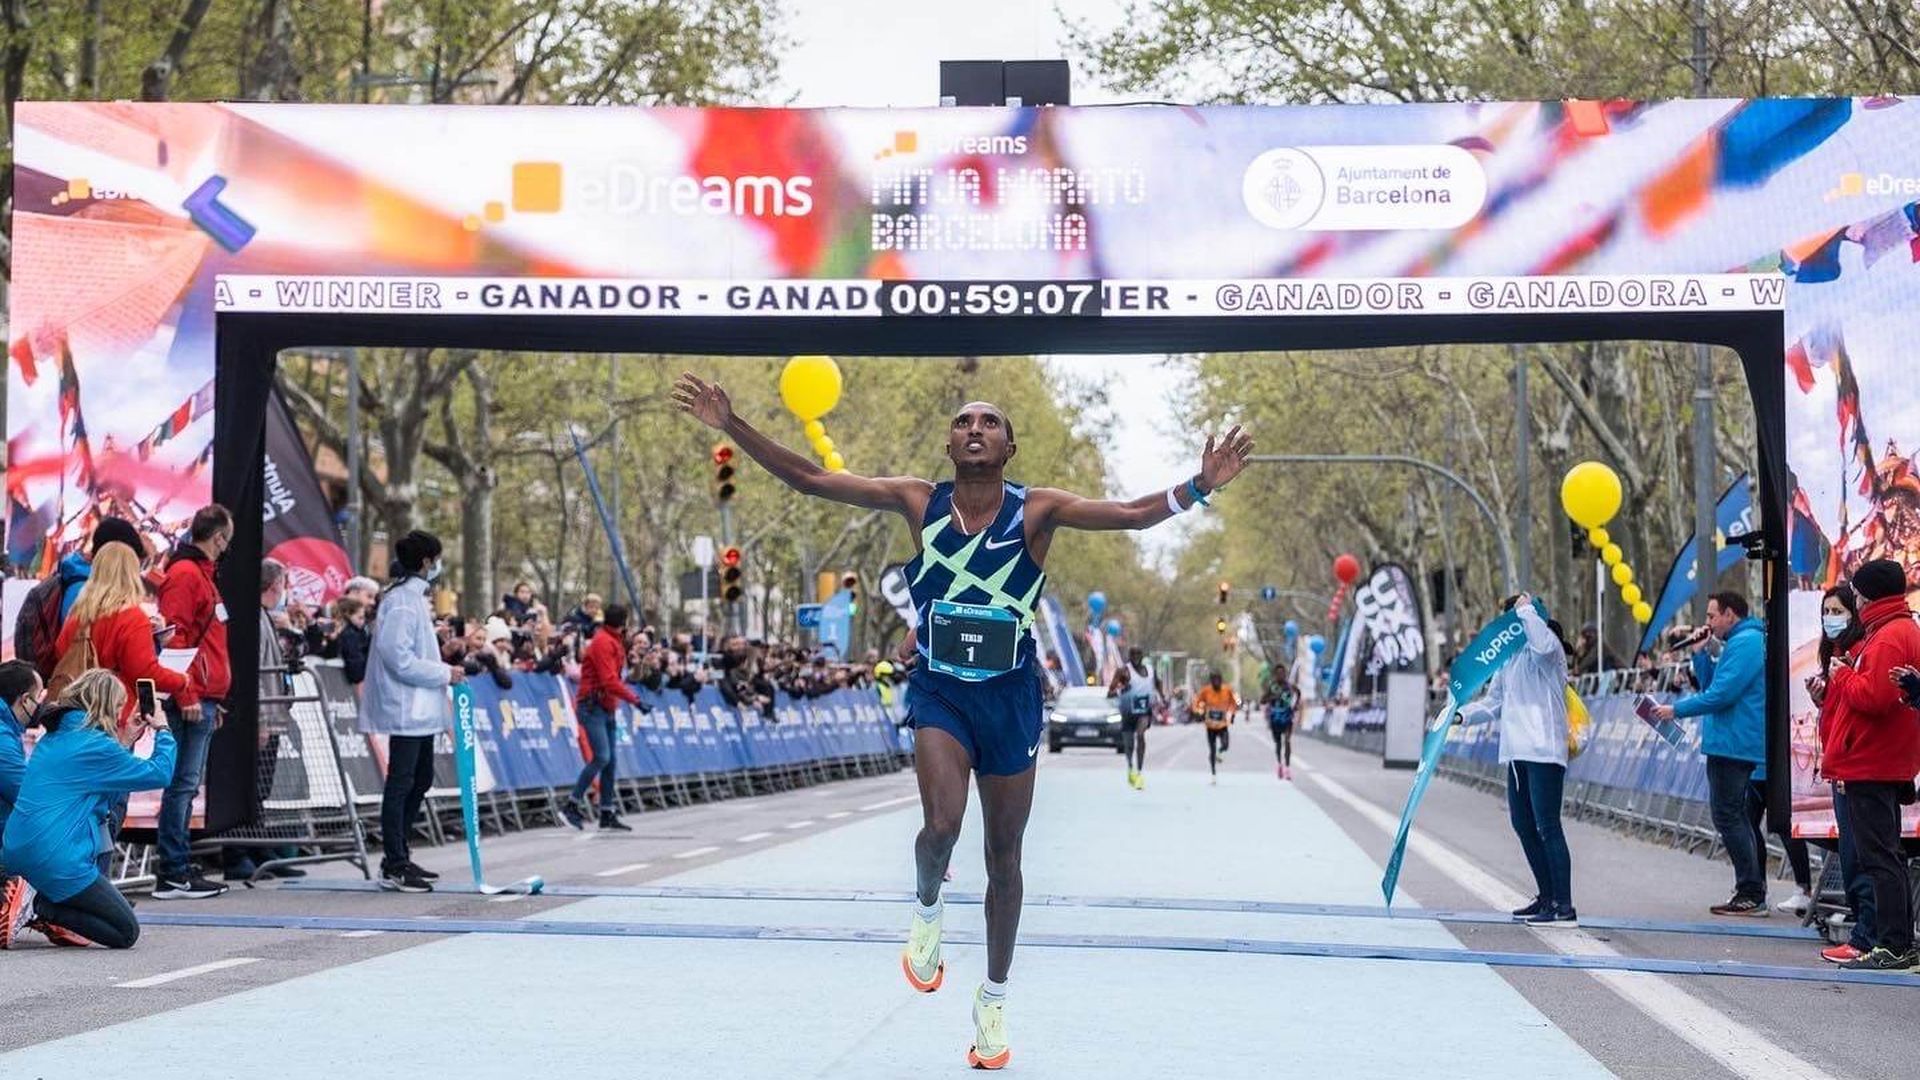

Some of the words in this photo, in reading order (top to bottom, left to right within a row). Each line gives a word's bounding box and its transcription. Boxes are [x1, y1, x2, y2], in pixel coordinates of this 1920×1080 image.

[577, 163, 812, 217] eDreams
[872, 168, 981, 204] MITJA
[998, 162, 1146, 204] MARATÓ
[1337, 166, 1429, 183] Ajuntament
[1432, 166, 1451, 179] de
[1337, 185, 1451, 204] Barcelona
[872, 213, 1086, 250] BARCELONA
[276, 281, 442, 309] WINNER
[480, 284, 681, 310] GANADOR
[726, 285, 883, 310] GANAD
[889, 283, 1094, 315] 00:59:07
[1216, 283, 1424, 310] GANADOR
[1467, 279, 1708, 309] GANADORA
[1750, 278, 1784, 305] W
[966, 646, 975, 662] 1
[1475, 622, 1524, 665] YoPRO
[457, 693, 473, 751] YoPRO
